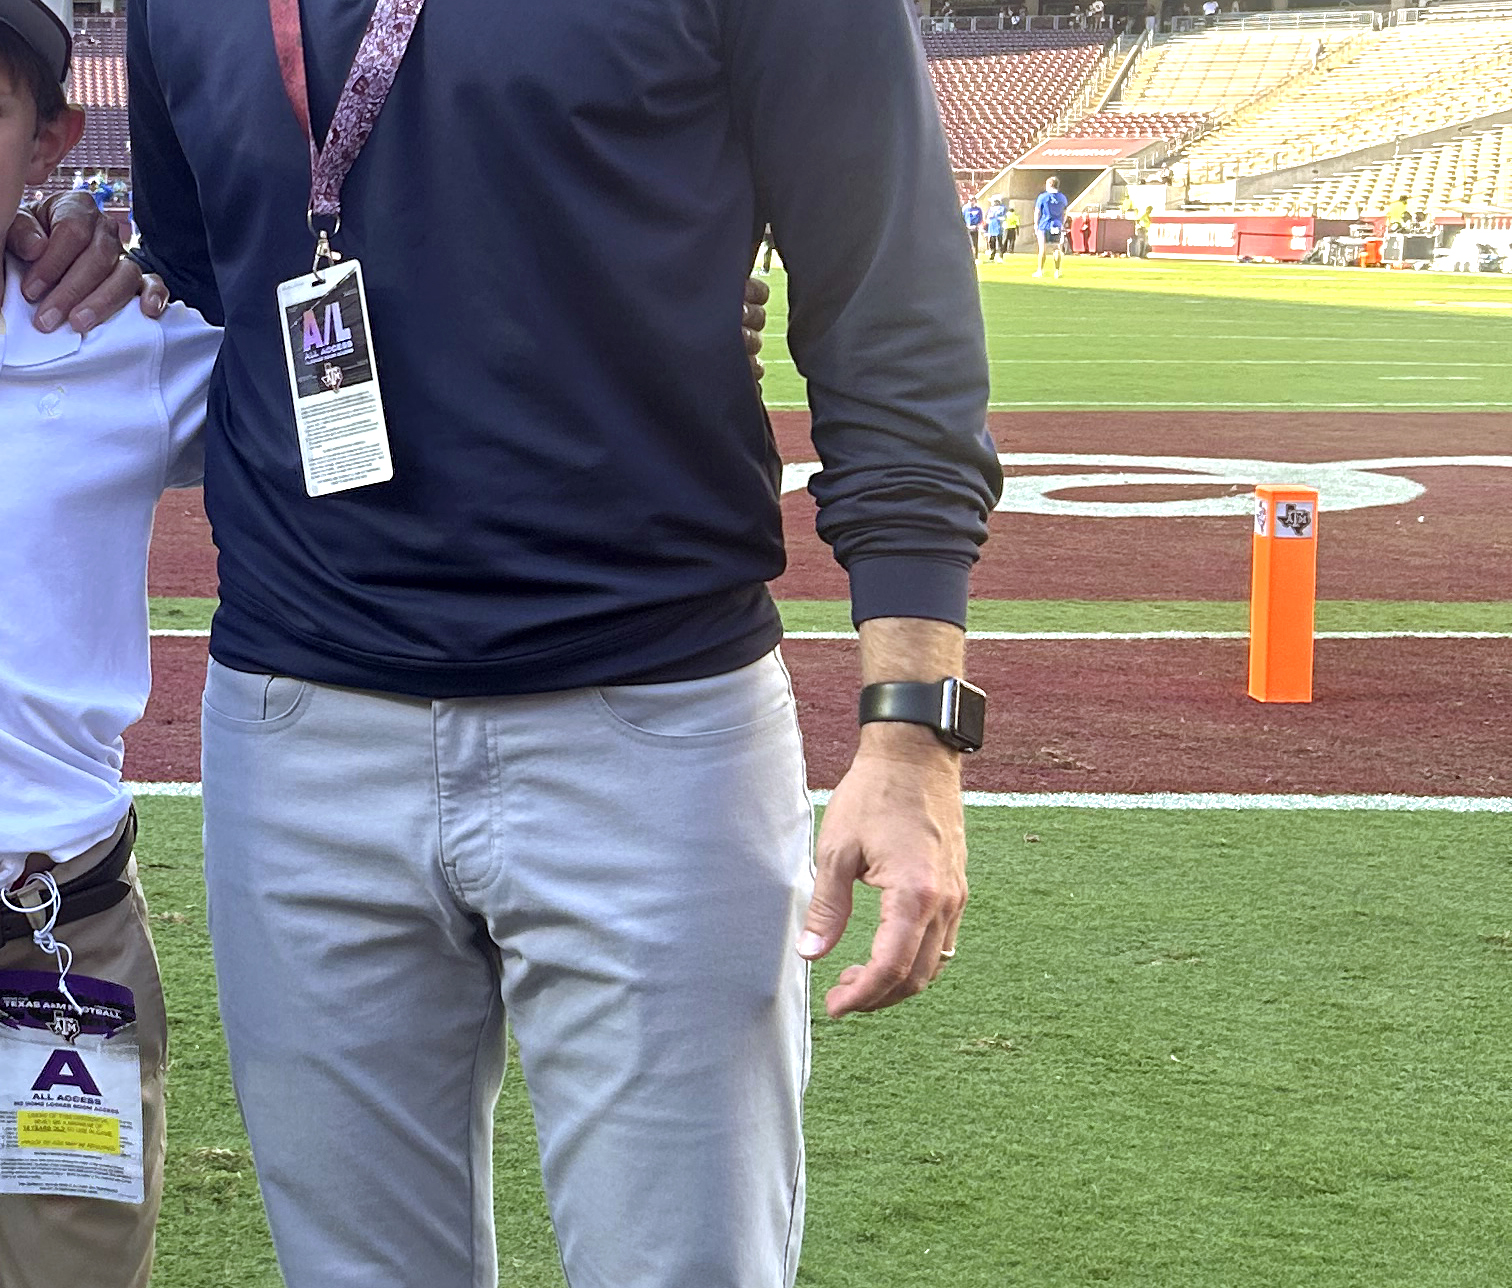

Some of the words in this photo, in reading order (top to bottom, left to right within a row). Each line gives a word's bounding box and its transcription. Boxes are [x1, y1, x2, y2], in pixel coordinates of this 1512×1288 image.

[4, 1000, 41, 1008] TEXAS
[42, 1002, 66, 1010] A&M
[31, 1049, 102, 1096] A
[57, 1094, 101, 1105] ACCESS
